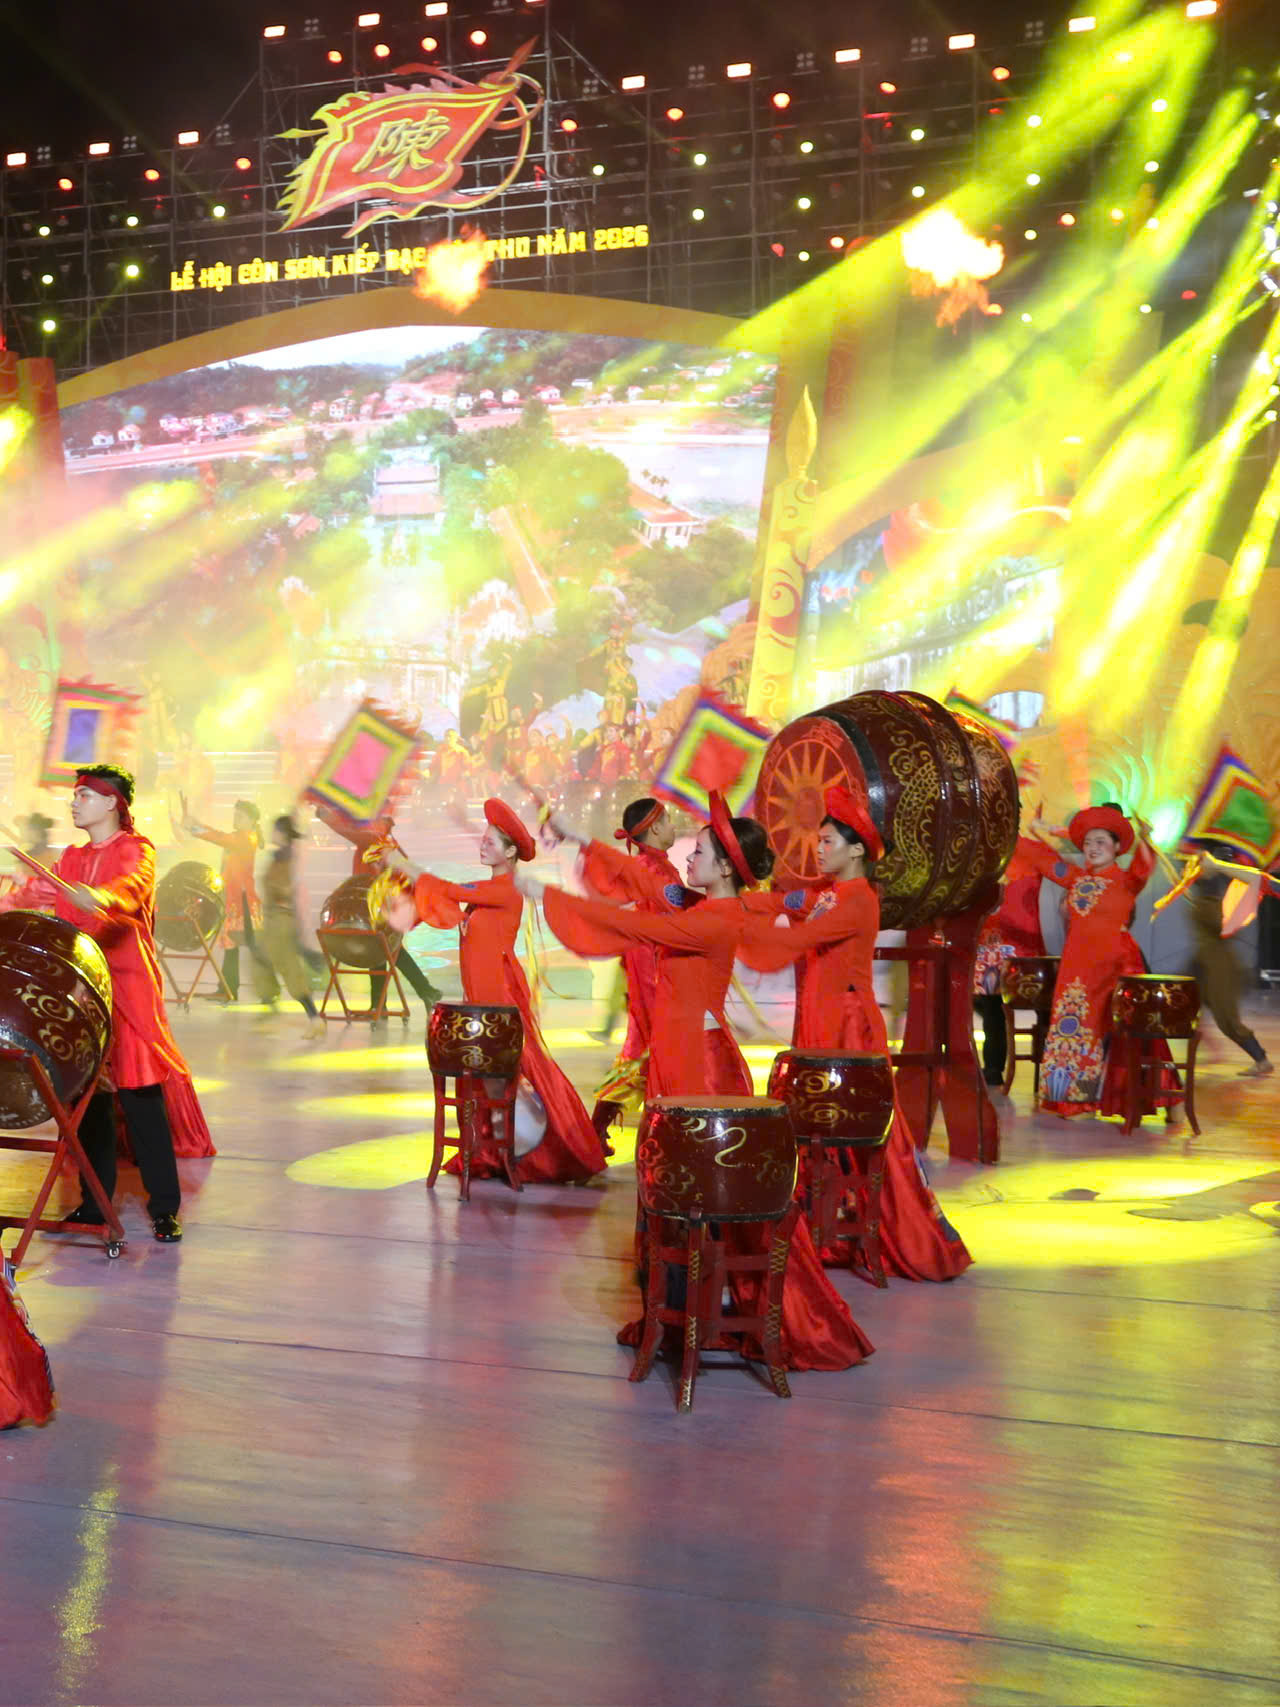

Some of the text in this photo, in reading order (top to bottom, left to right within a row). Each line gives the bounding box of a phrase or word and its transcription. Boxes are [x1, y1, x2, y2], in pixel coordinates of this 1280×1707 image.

[351, 108, 451, 180] 陳
[537, 227, 587, 257] NĂM
[593, 225, 649, 251] 2026
